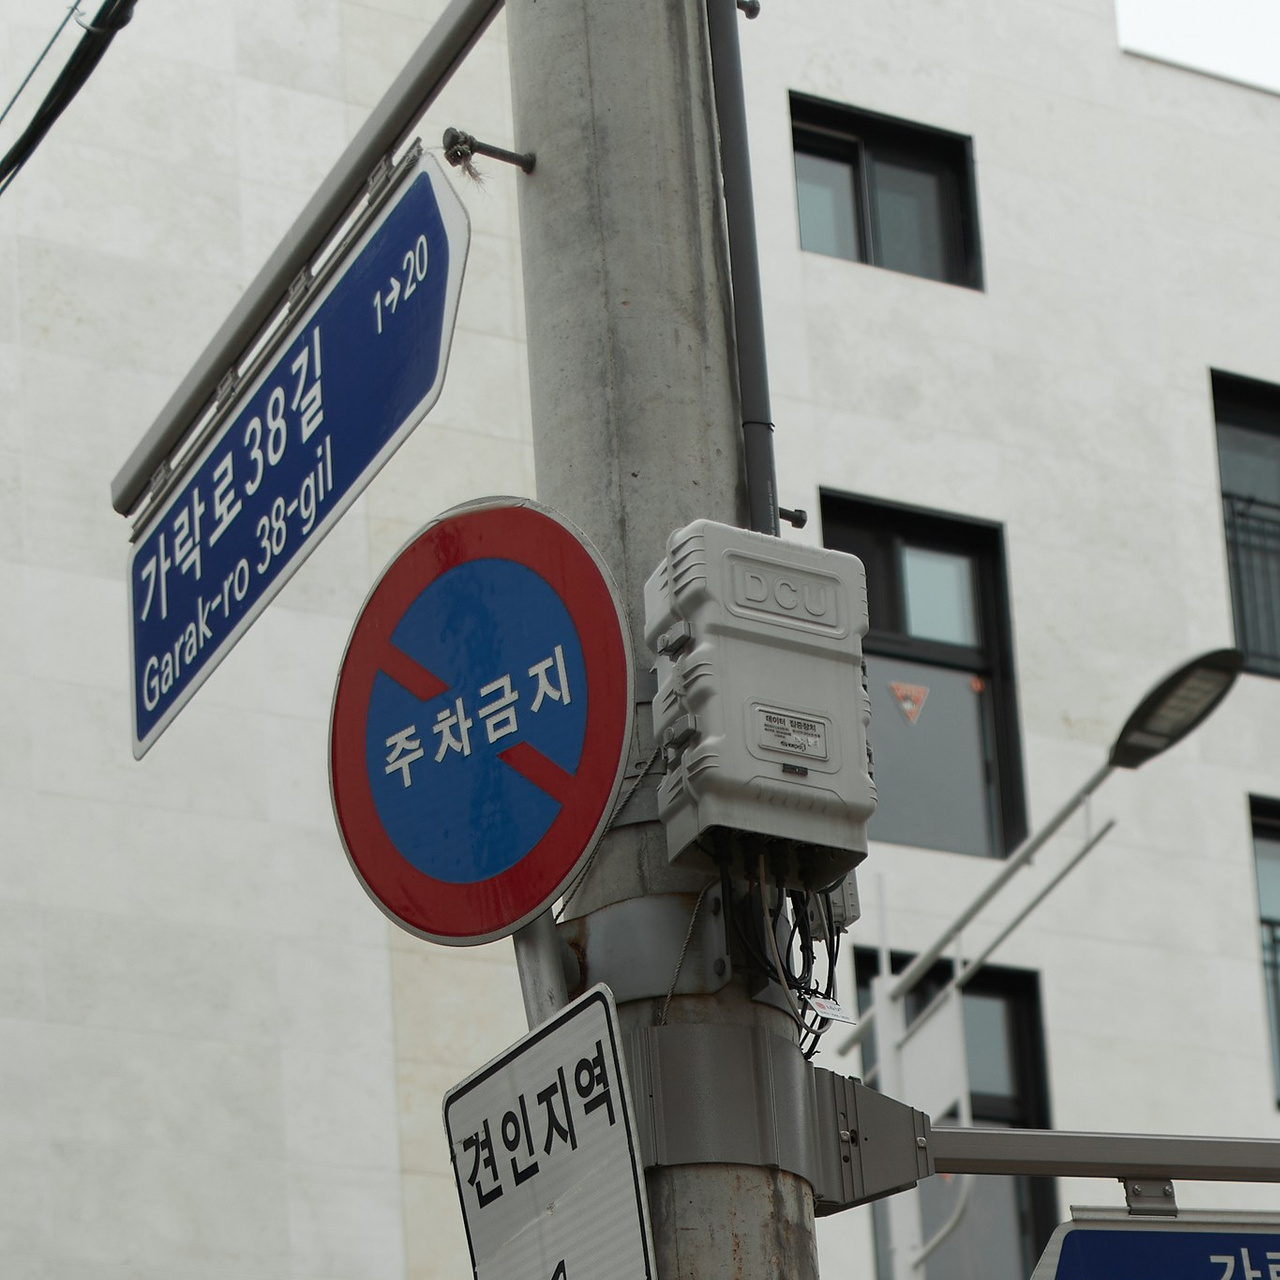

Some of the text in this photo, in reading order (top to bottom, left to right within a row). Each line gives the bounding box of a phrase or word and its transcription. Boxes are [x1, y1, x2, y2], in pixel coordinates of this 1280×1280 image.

[403, 234, 430, 286] 20
[140, 326, 324, 622] 가락로38길
[144, 435, 334, 713] Garak-ro 38-gil
[744, 571, 827, 617] DCU
[384, 644, 571, 788] 주차금지
[766, 715, 785, 726] 데이터
[462, 1041, 617, 1210] 견인지역
